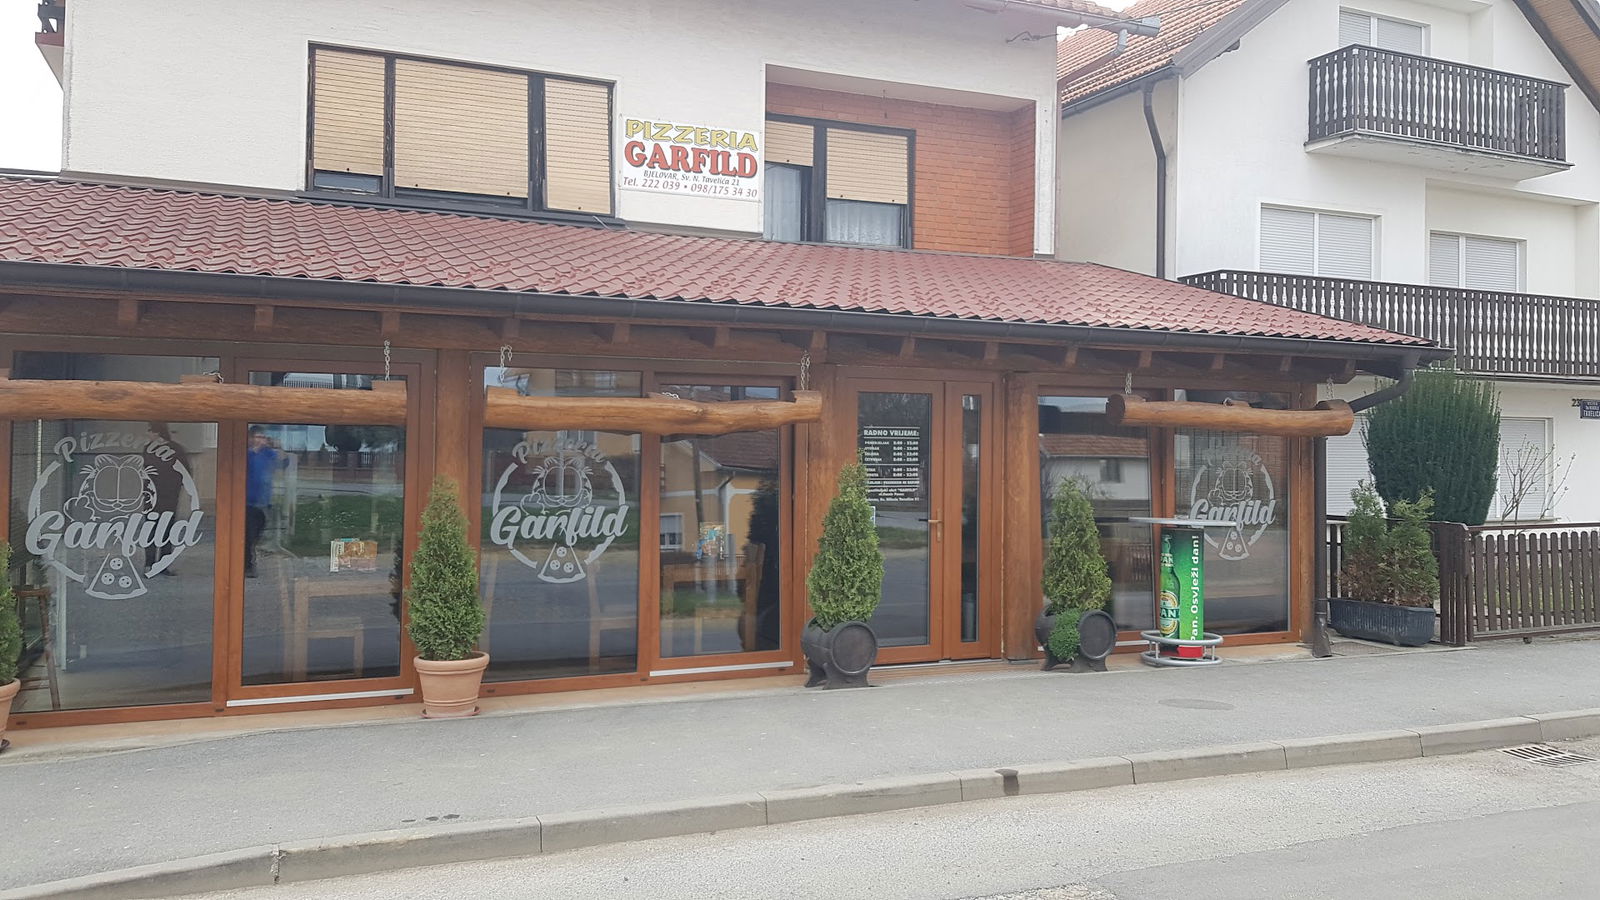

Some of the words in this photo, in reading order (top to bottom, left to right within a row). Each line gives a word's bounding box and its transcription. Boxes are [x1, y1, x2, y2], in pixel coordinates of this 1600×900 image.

[625, 118, 758, 152] PIZZERIA
[624, 140, 758, 178] GARFILD
[623, 176, 639, 187] Tel.
[642, 178, 660, 189] 222
[662, 180, 681, 190] 039
[690, 183, 729, 195] 098/175
[732, 187, 743, 196] 34
[746, 188, 758, 198] 30
[643, 170, 679, 181] BJELOVAR,
[730, 178, 740, 186] 21
[54, 430, 178, 463] Pizzeria
[490, 504, 629, 547] Garfild
[1189, 498, 1277, 531] Garfild
[25, 510, 204, 557] Garfild
[1191, 535, 1199, 564] dan!
[1190, 567, 1199, 614] Osvježi
[1160, 608, 1177, 618] AN
